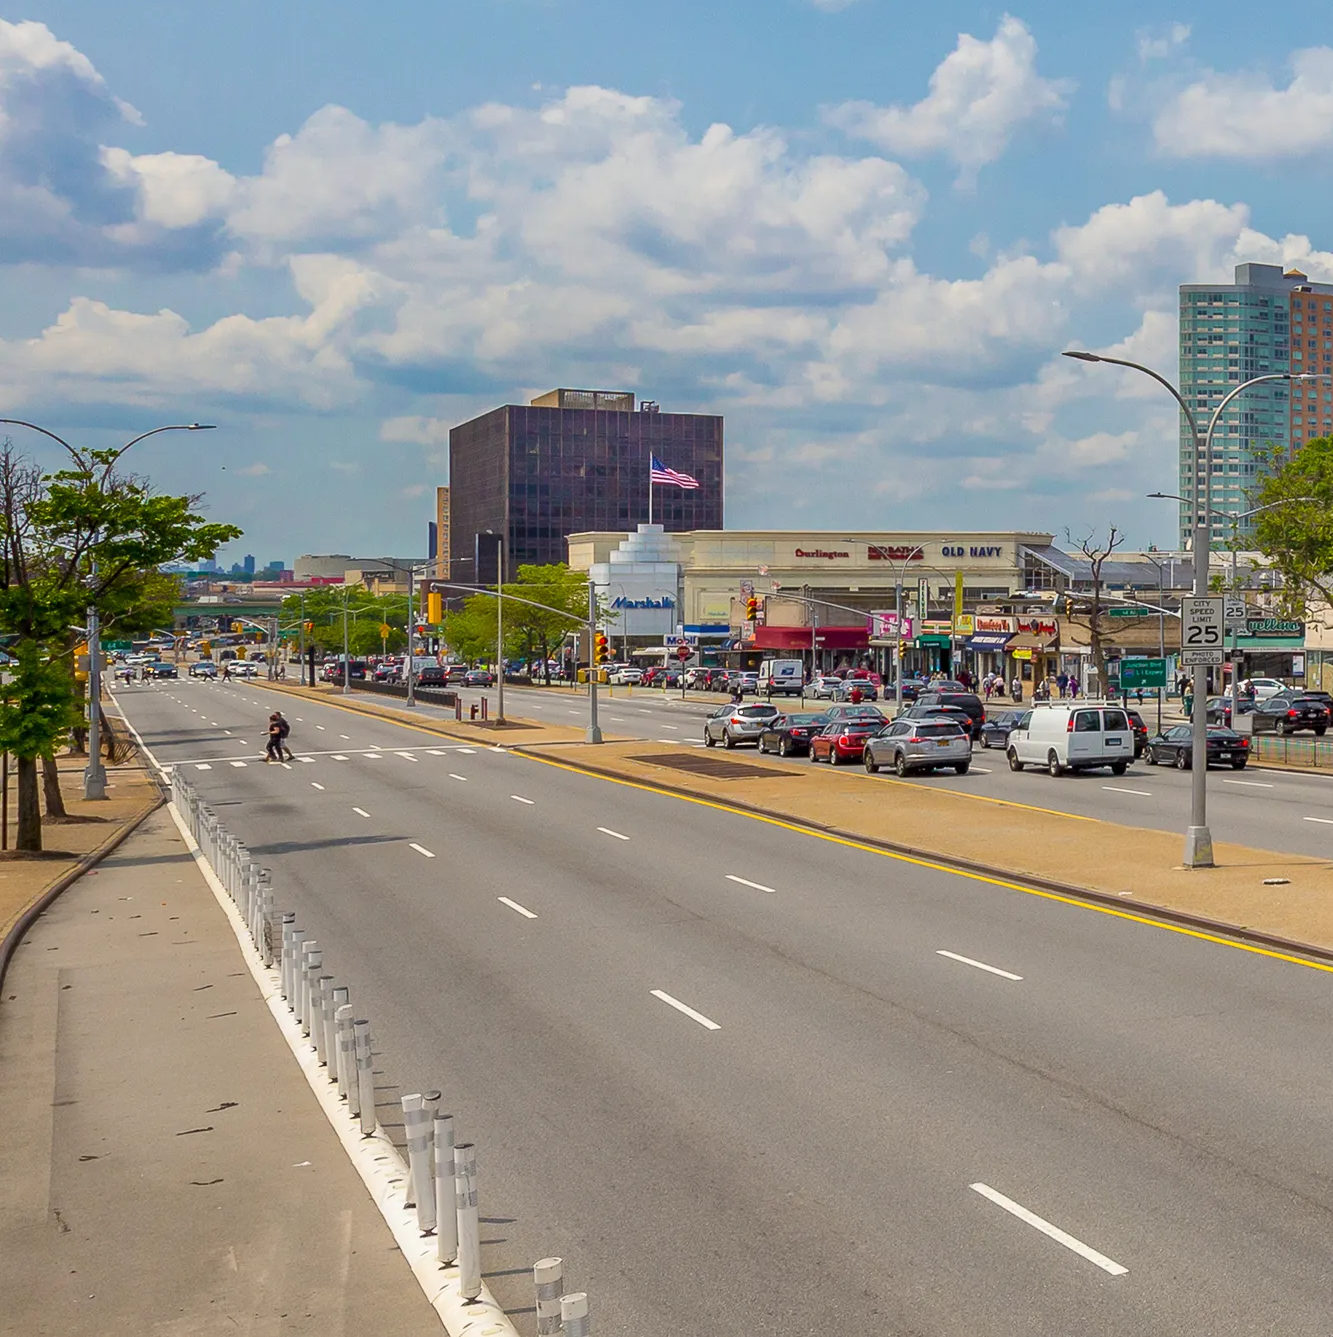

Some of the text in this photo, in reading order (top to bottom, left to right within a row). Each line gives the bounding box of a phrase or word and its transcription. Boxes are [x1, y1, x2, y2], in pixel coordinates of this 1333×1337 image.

[795, 548, 849, 560] Burlington
[942, 546, 1002, 557] OLD NAVY
[610, 596, 676, 609] Marshalls
[1226, 607, 1244, 617] 25
[1187, 625, 1219, 643] 25
[667, 636, 696, 645] Mobil
